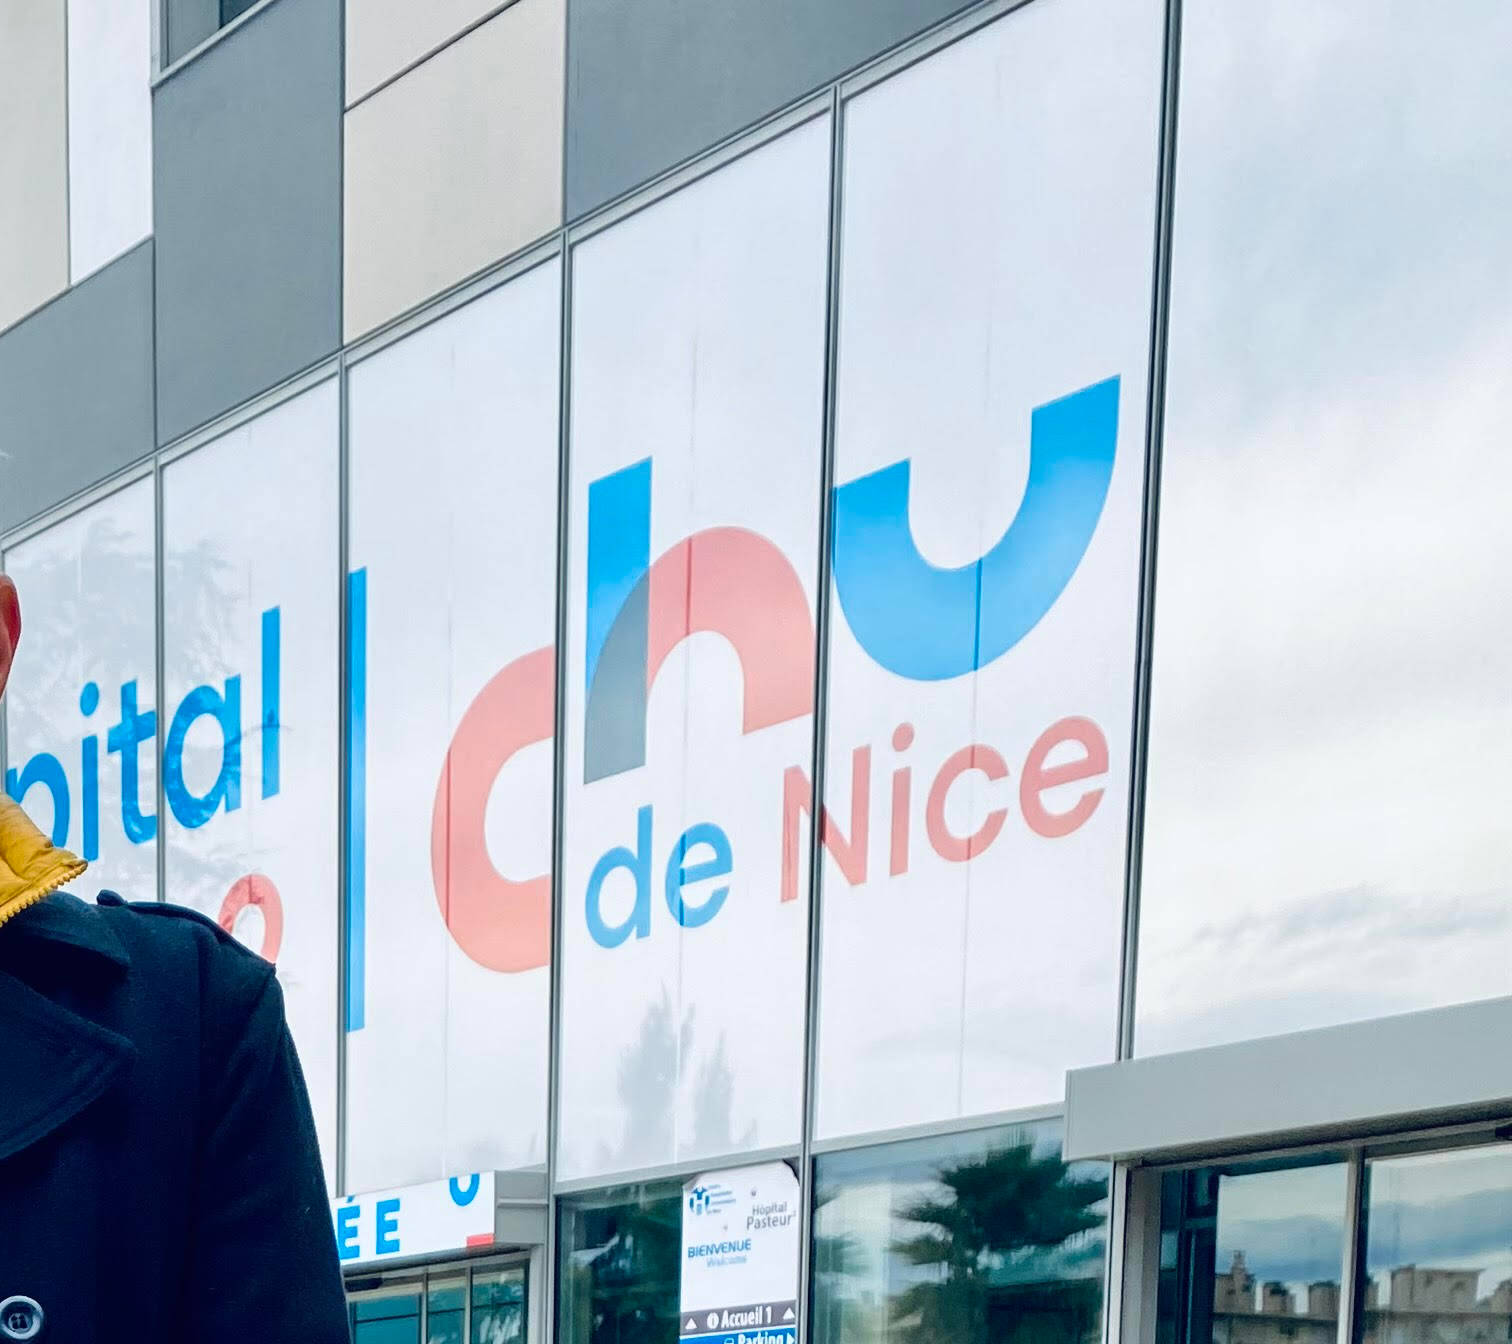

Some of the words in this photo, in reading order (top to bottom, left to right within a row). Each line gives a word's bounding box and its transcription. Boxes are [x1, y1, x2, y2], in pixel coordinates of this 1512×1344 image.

[432, 374, 1121, 973] chu
[585, 804, 733, 949] de
[780, 716, 1109, 904] Nice
[688, 1239, 751, 1258] BIENVENUE
[721, 1306, 763, 1328] Accueil
[766, 1306, 772, 1324] 1
